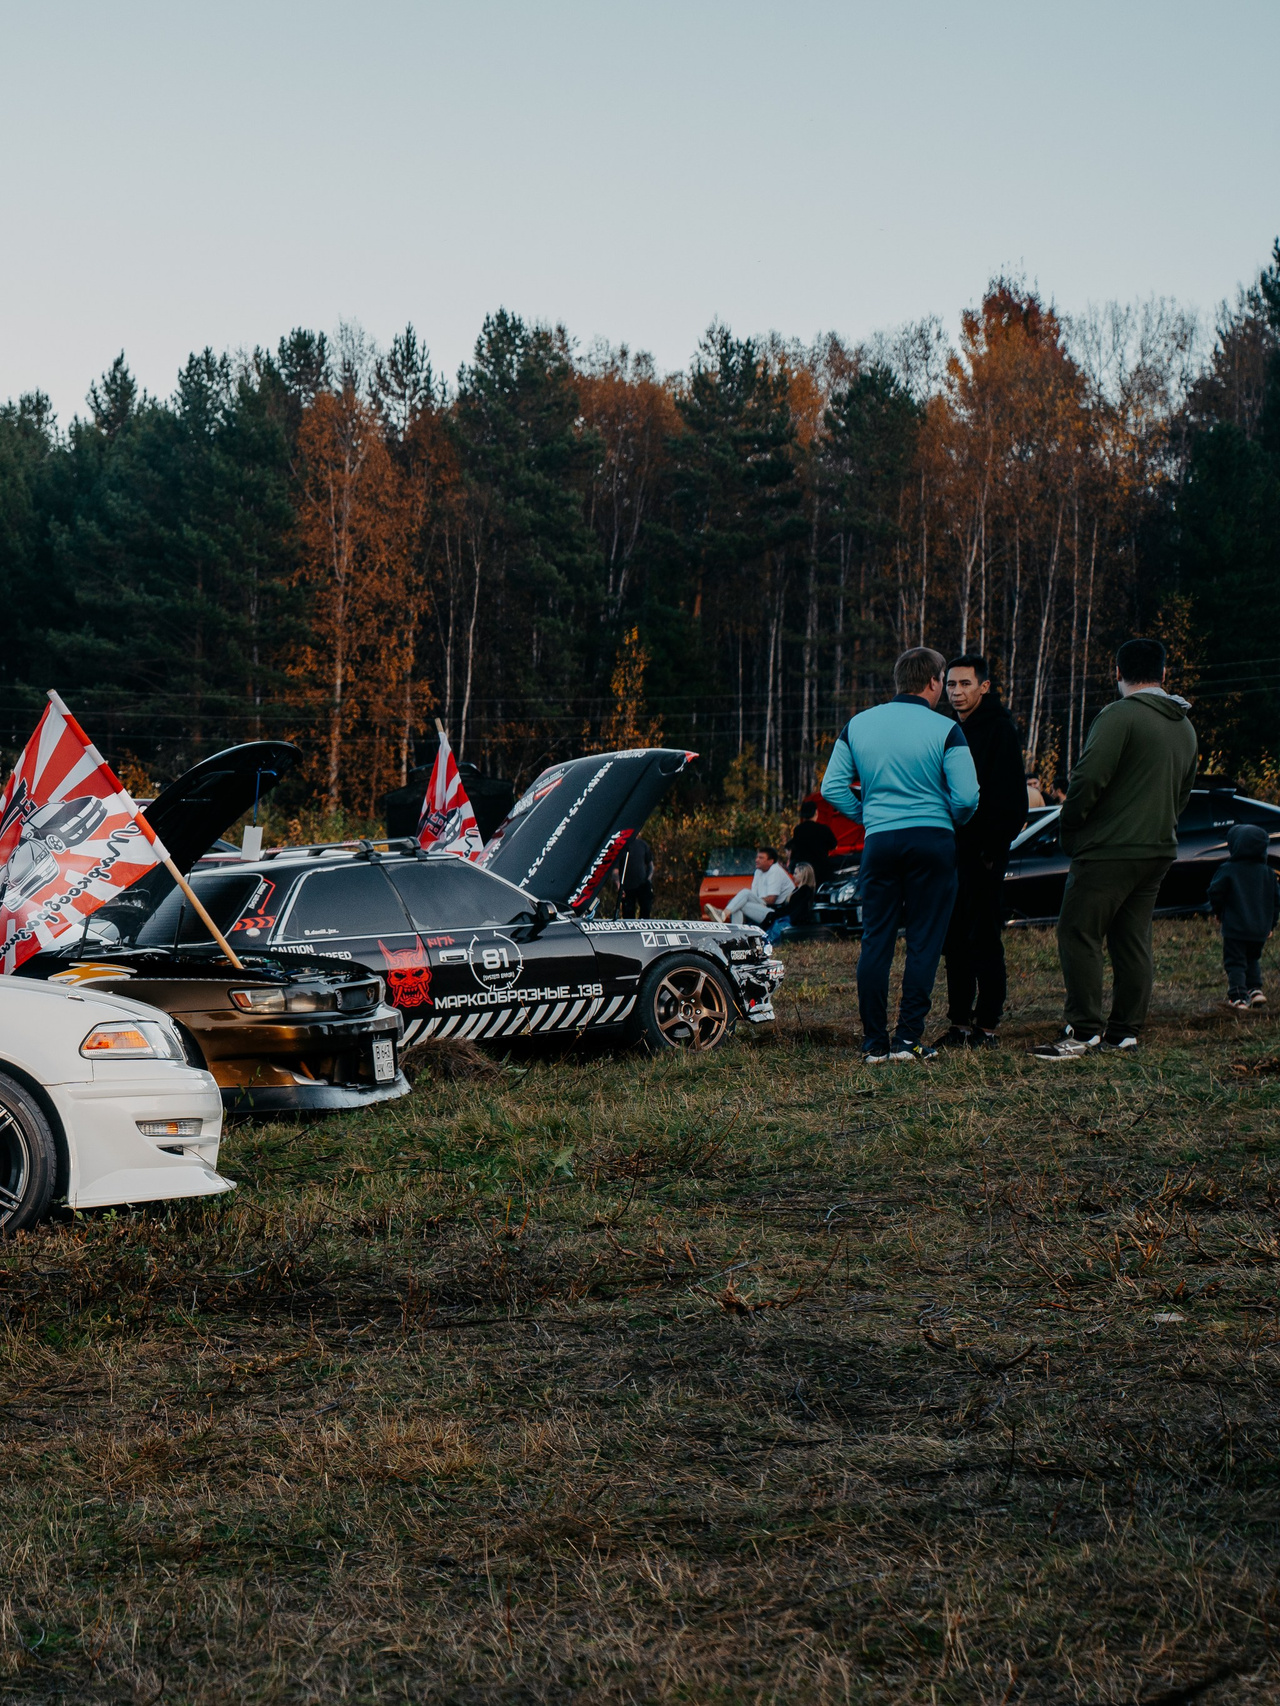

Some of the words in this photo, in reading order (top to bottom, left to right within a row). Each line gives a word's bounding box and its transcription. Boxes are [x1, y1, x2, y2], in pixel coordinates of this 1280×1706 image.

[581, 922, 625, 931] DANGER!
[627, 921, 686, 930] PROTOTYPE
[687, 922, 730, 931] VERSION
[270, 945, 315, 955] CAUTION
[482, 948, 510, 970] 81
